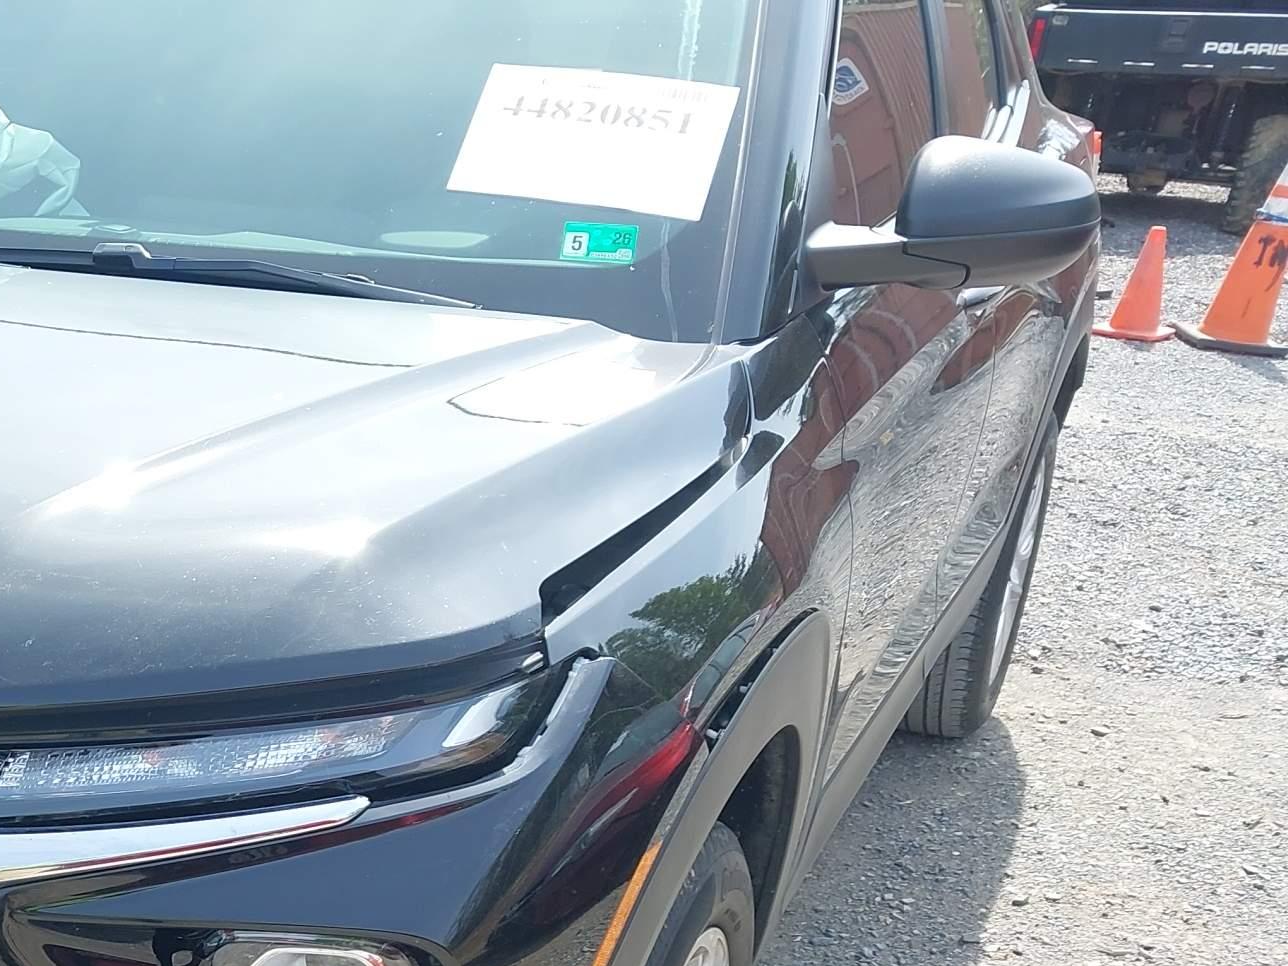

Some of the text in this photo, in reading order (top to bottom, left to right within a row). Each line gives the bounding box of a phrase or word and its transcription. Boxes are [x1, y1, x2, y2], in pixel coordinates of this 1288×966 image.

[1202, 41, 1288, 57] POLARIS
[502, 95, 693, 134] 44820851
[571, 235, 583, 251] 5
[612, 231, 633, 246] 26
